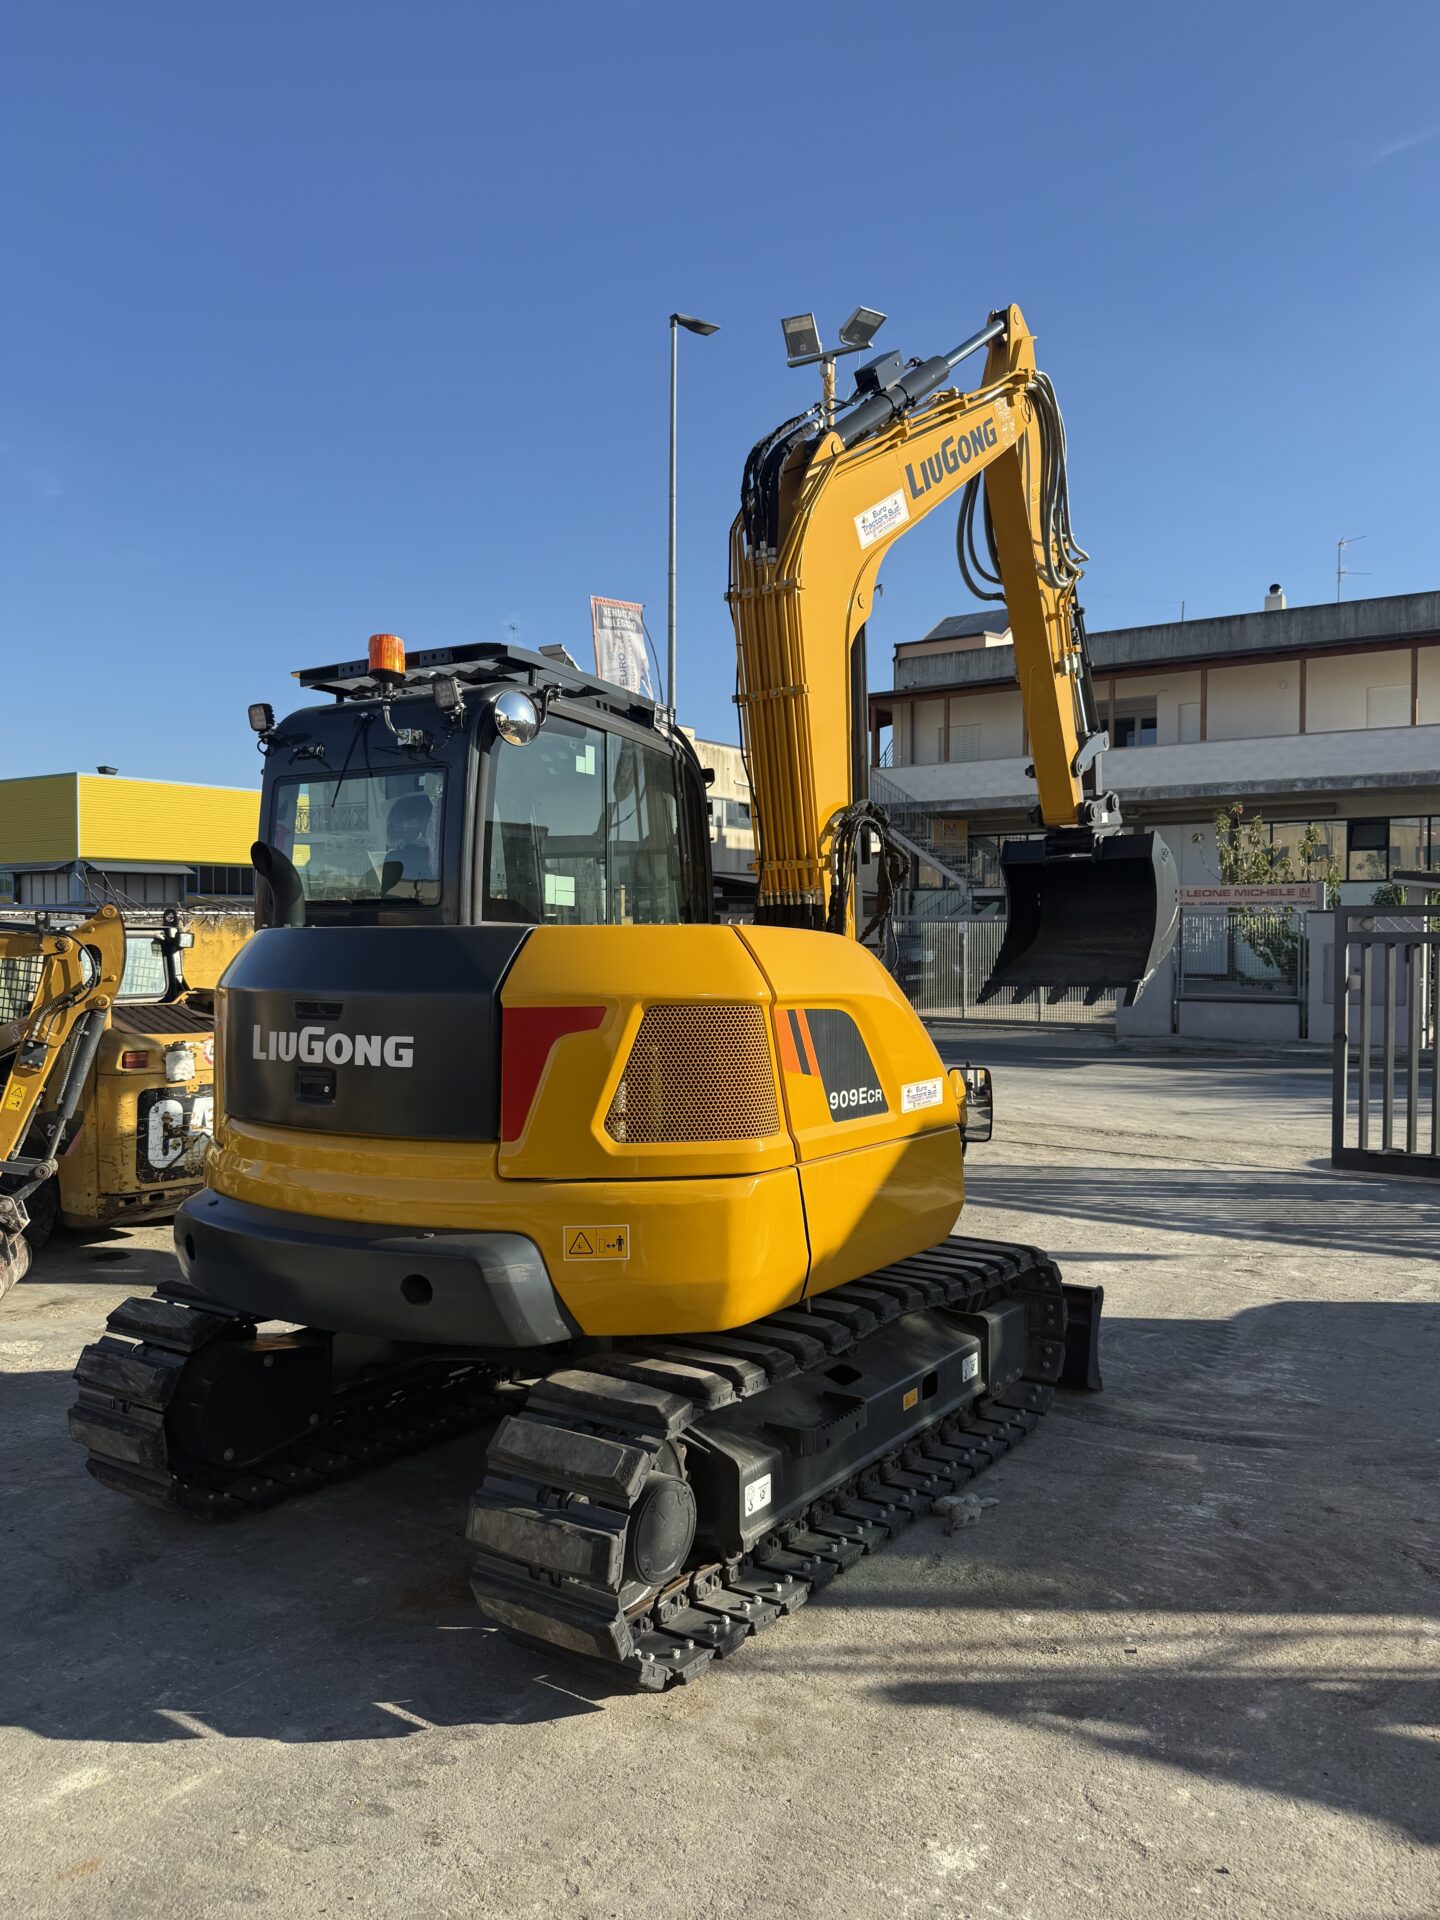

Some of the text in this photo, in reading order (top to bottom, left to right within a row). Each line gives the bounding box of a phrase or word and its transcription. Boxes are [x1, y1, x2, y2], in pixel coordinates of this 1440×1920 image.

[872, 506, 887, 518] Euro
[618, 653, 628, 686] EURO
[1186, 889, 1231, 897] LEONE
[1234, 888, 1296, 897] MICHELE
[829, 1087, 883, 1110] 909ECR
[148, 1097, 214, 1169] CA
